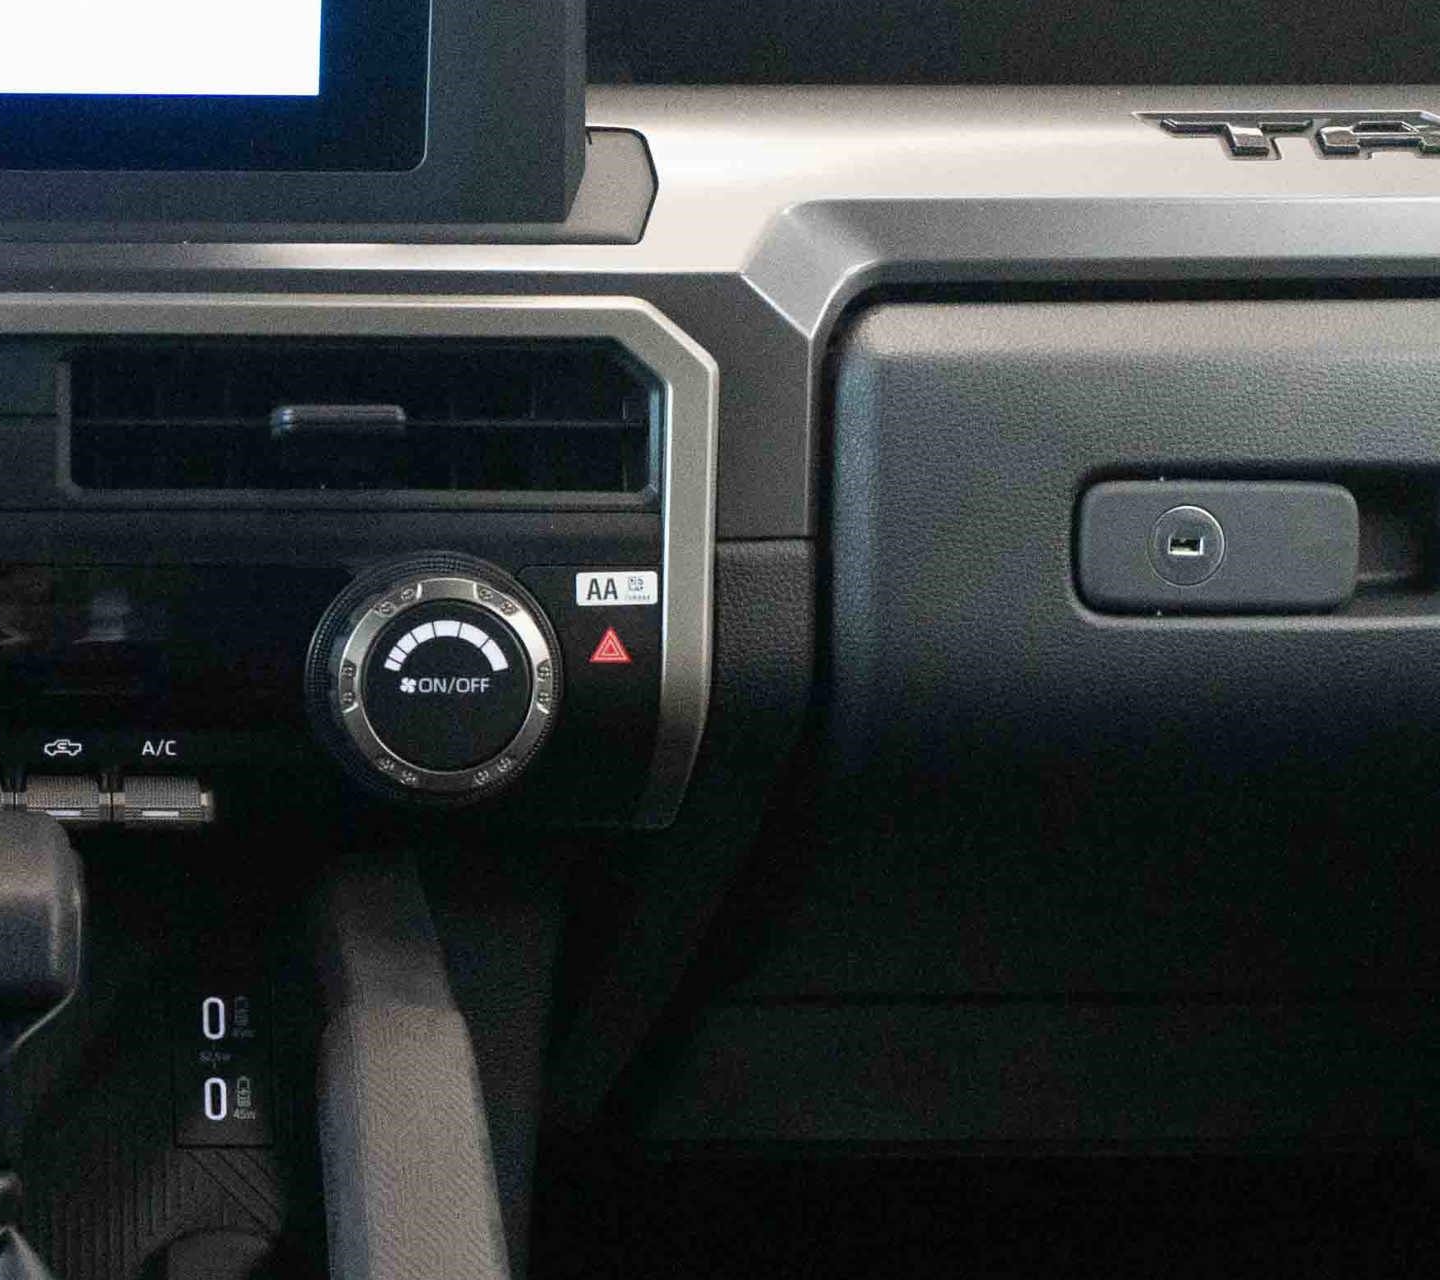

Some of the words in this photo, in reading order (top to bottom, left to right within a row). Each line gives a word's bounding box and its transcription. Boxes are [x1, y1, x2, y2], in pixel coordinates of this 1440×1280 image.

[586, 577, 619, 601] AA
[418, 677, 490, 694] ON/OFF
[141, 739, 176, 757] A/C
